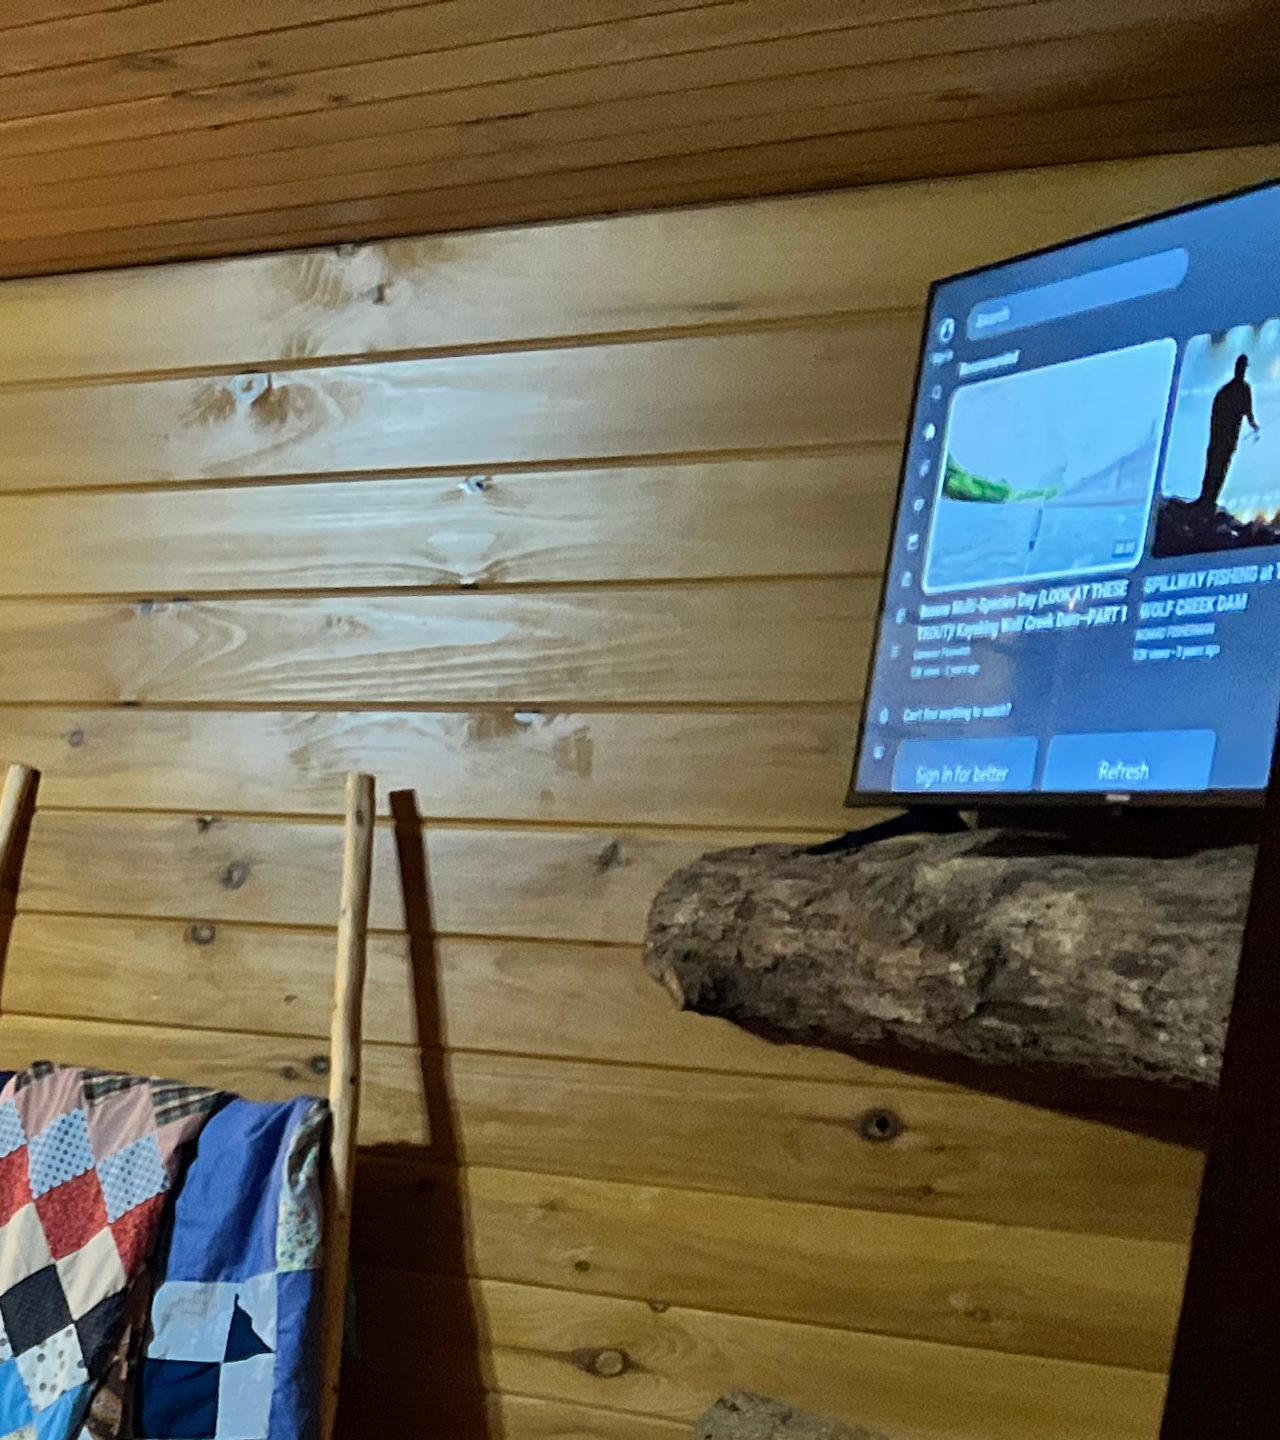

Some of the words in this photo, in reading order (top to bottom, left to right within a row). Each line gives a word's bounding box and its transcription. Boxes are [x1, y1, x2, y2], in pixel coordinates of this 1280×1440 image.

[1144, 571, 1207, 594] SPILLWAY
[1206, 565, 1258, 588] FISHING
[1018, 592, 1038, 610] Day
[1073, 585, 1090, 600] AT
[1090, 579, 1129, 599] THESE
[1140, 600, 1175, 619] WOLF
[1175, 596, 1217, 616] CREEK
[1217, 593, 1248, 612] DAM
[1025, 613, 1054, 630] Creek
[916, 766, 939, 789] Sign
[955, 765, 972, 783] for
[973, 765, 1009, 783] better
[1099, 761, 1149, 780] Refresh
